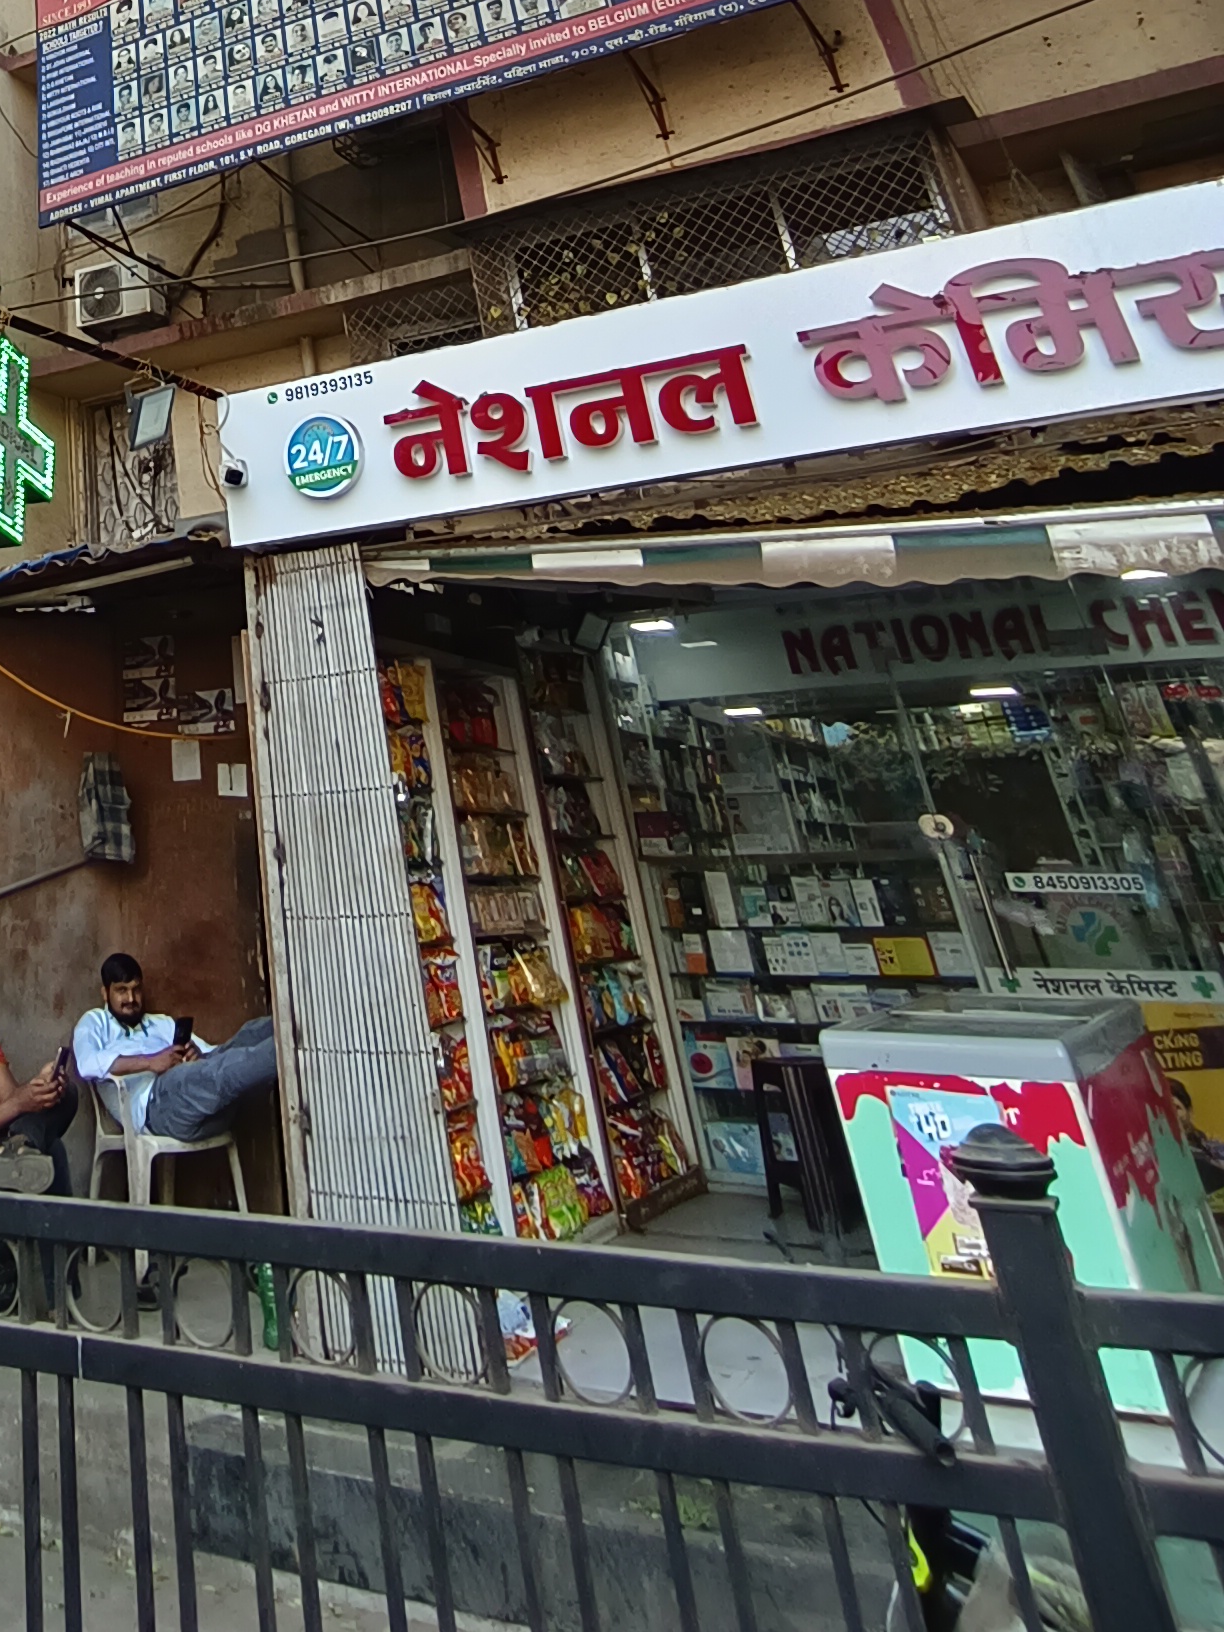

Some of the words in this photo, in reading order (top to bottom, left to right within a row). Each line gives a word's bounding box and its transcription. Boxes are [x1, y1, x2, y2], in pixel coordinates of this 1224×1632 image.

[42, 6, 71, 25] SINCE
[46, 179, 94, 204] Experience
[95, 172, 104, 187] of
[106, 157, 145, 183] teaching
[146, 155, 156, 170] in
[157, 145, 193, 171] reputed
[195, 134, 233, 155] schools
[235, 126, 253, 142] like
[255, 118, 272, 135] DG
[273, 107, 317, 130] KHETAN
[319, 102, 338, 116] and
[340, 89, 376, 110] WITTY
[529, 28, 570, 50] invited
[572, 24, 586, 36] to
[588, 3, 650, 31] BELGIUM
[49, 204, 83, 222] ADDRESS
[164, 168, 187, 186] FIRST
[285, 126, 332, 147] GOREGAON
[285, 370, 374, 402] 9819393135
[383, 344, 759, 480] नेशनल
[290, 434, 349, 469] 24/7
[295, 463, 353, 486] EMERGENCY
[781, 603, 1052, 676] NATIONAL
[1033, 875, 1145, 891] 8450913305
[1033, 971, 1104, 996] नेशनल
[1105, 971, 1179, 998] केमिस्ट
